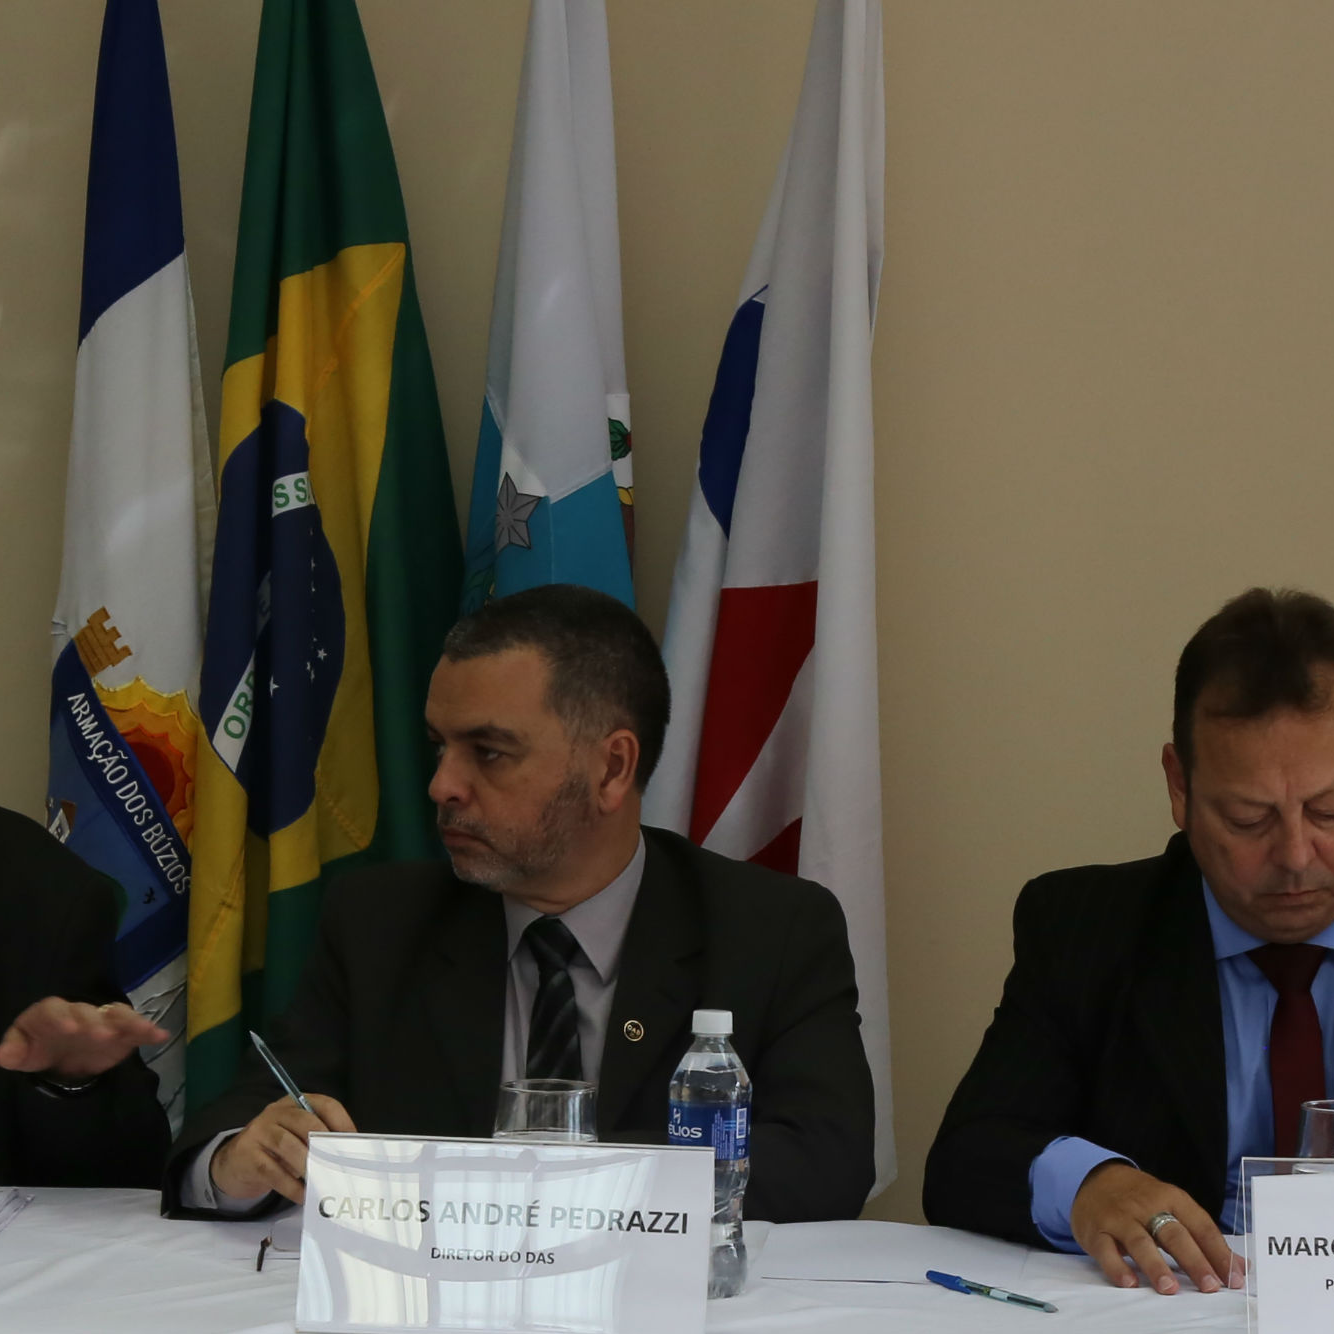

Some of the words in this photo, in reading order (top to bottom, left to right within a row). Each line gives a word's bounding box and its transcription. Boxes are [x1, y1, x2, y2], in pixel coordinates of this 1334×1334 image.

[67, 693, 129, 785] ARMAÇÃO
[116, 780, 154, 826] DOS
[142, 822, 191, 894] BÚZIOS
[668, 1121, 702, 1138] ÉLIOS
[318, 1195, 430, 1223] CARLOS
[438, 1200, 540, 1228] ANDRÉ
[550, 1206, 688, 1235] PEDRAZZI
[431, 1247, 493, 1262] DIRETOR
[498, 1250, 521, 1263] DO
[525, 1251, 555, 1265] DAS
